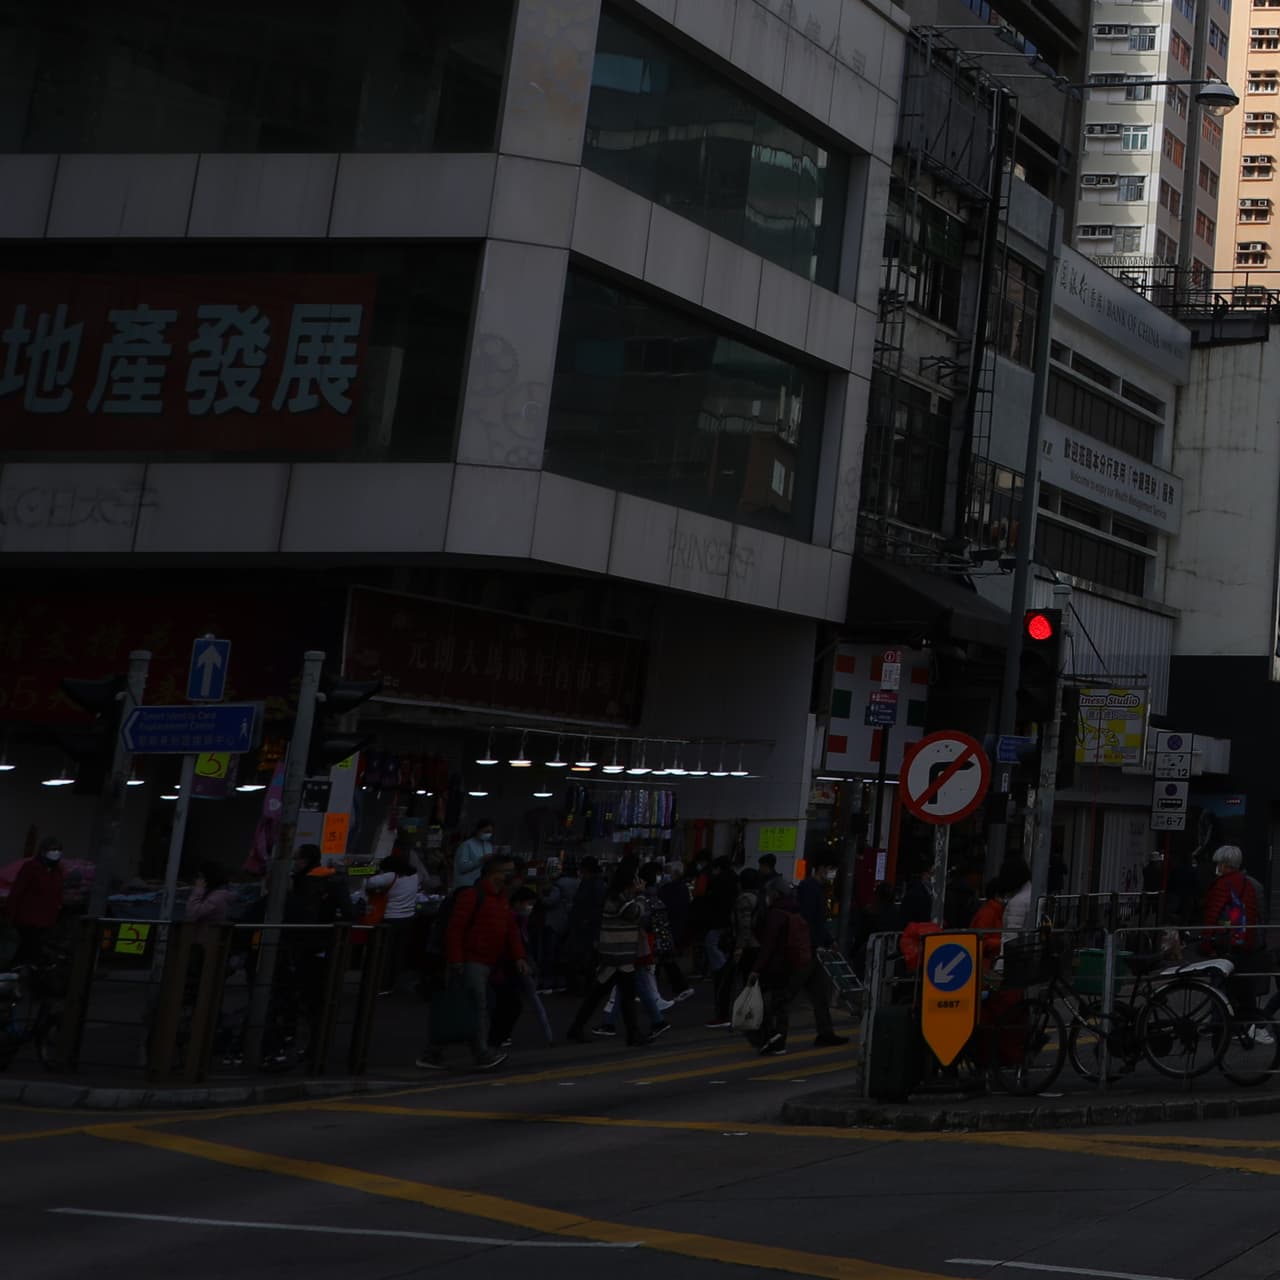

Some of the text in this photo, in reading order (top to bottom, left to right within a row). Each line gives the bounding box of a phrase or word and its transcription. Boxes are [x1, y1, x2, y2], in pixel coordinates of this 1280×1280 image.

[1138, 323, 1160, 349] CHINA
[0, 303, 364, 416] 地產發展
[1107, 694, 1140, 706] Studio
